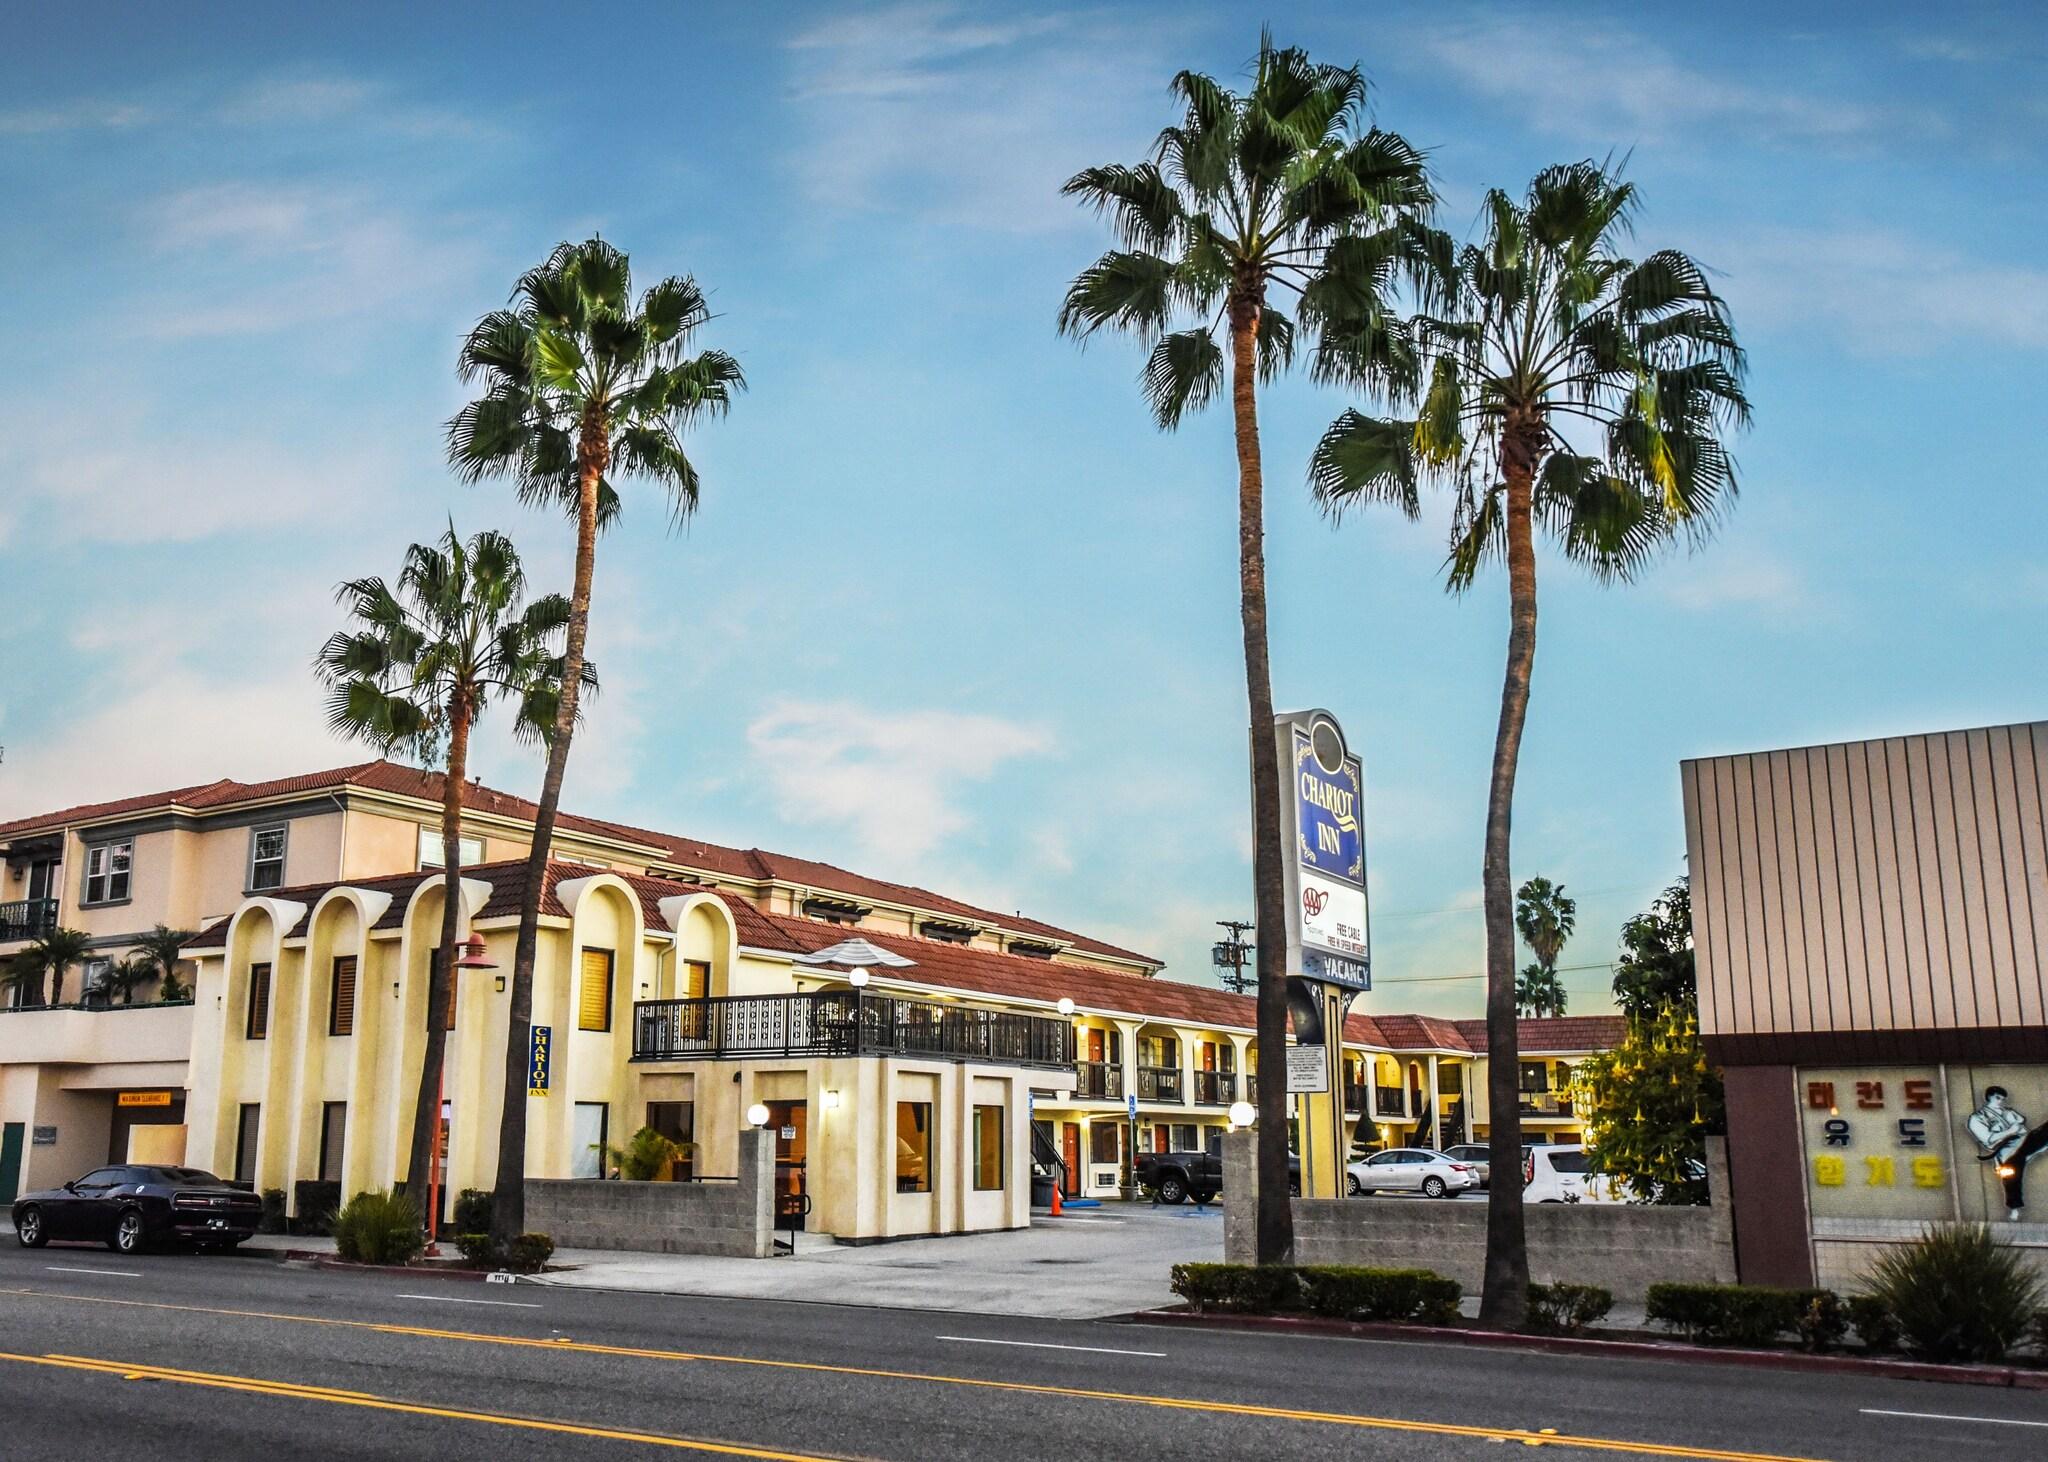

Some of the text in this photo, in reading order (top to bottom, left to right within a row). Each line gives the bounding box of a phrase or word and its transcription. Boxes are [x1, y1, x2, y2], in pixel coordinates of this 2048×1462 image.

[1302, 772, 1355, 822] CHARIOT
[1317, 821, 1340, 856] INN
[1336, 922, 1347, 938] FREE
[1324, 956, 1369, 984] VACANCY
[533, 1027, 547, 1089] CHARIOT
